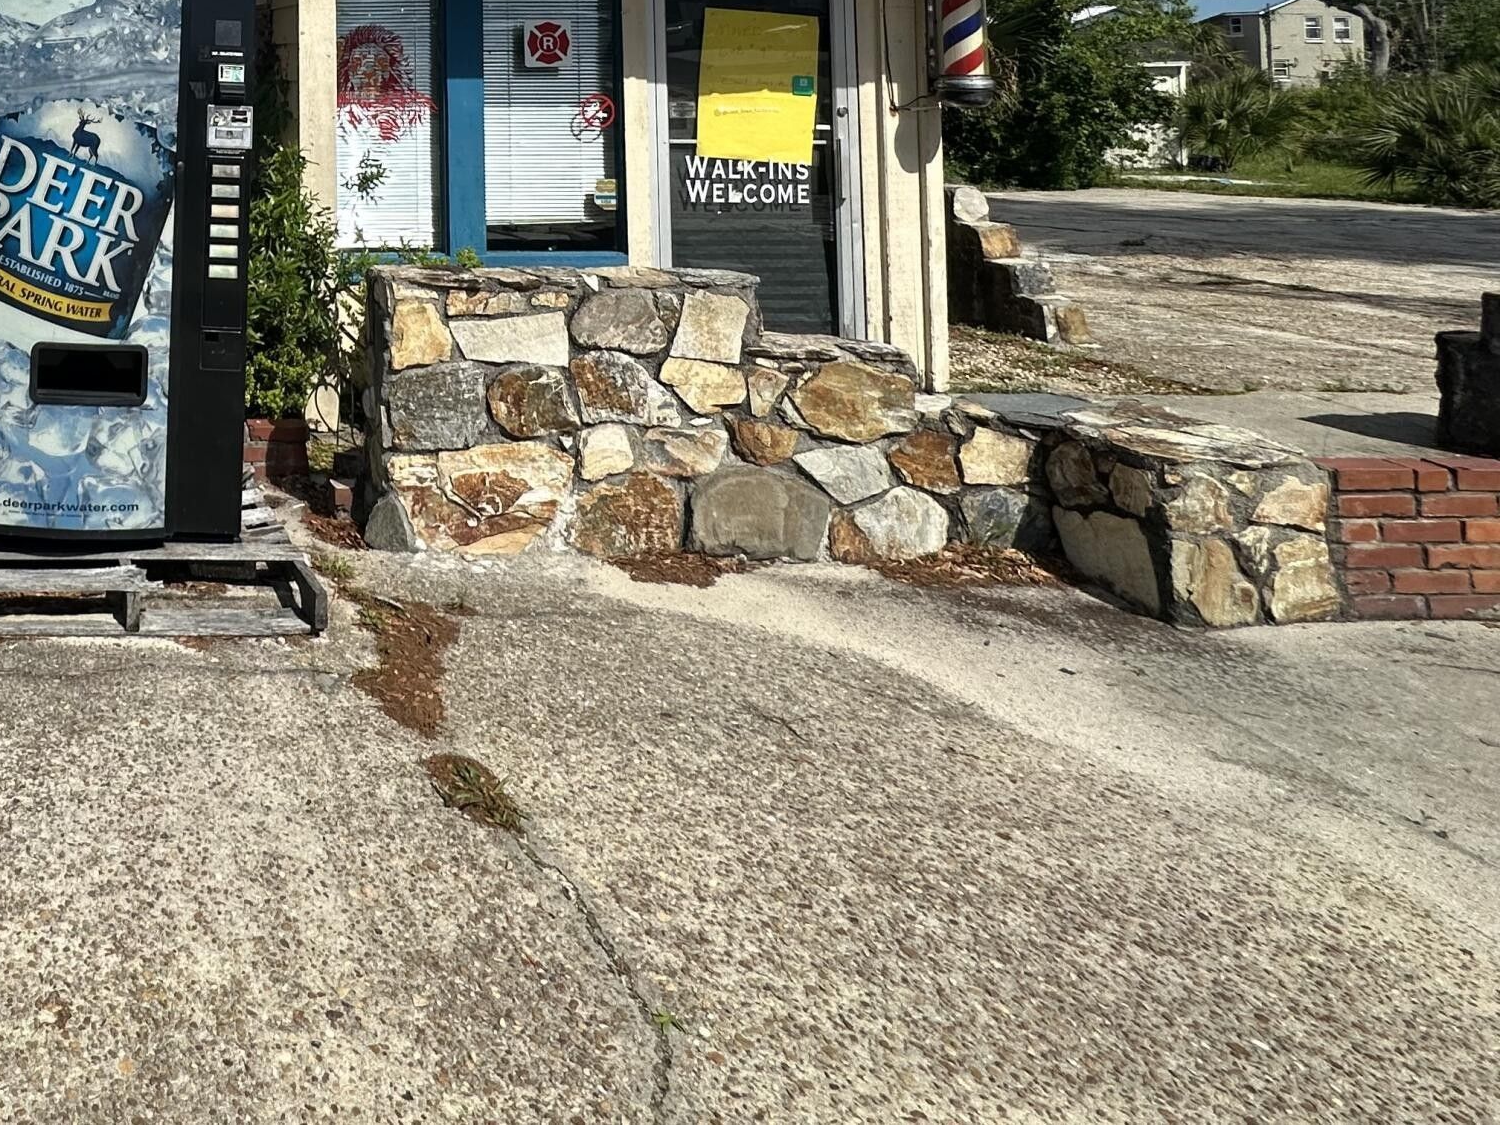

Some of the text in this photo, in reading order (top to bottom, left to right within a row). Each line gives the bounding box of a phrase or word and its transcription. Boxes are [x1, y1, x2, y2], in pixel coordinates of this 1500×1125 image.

[543, 36, 554, 50] R
[685, 155, 809, 180] WALK-INS
[686, 180, 810, 204] WELCOME
[19, 287, 63, 312] SPRING
[66, 302, 102, 318] WATER
